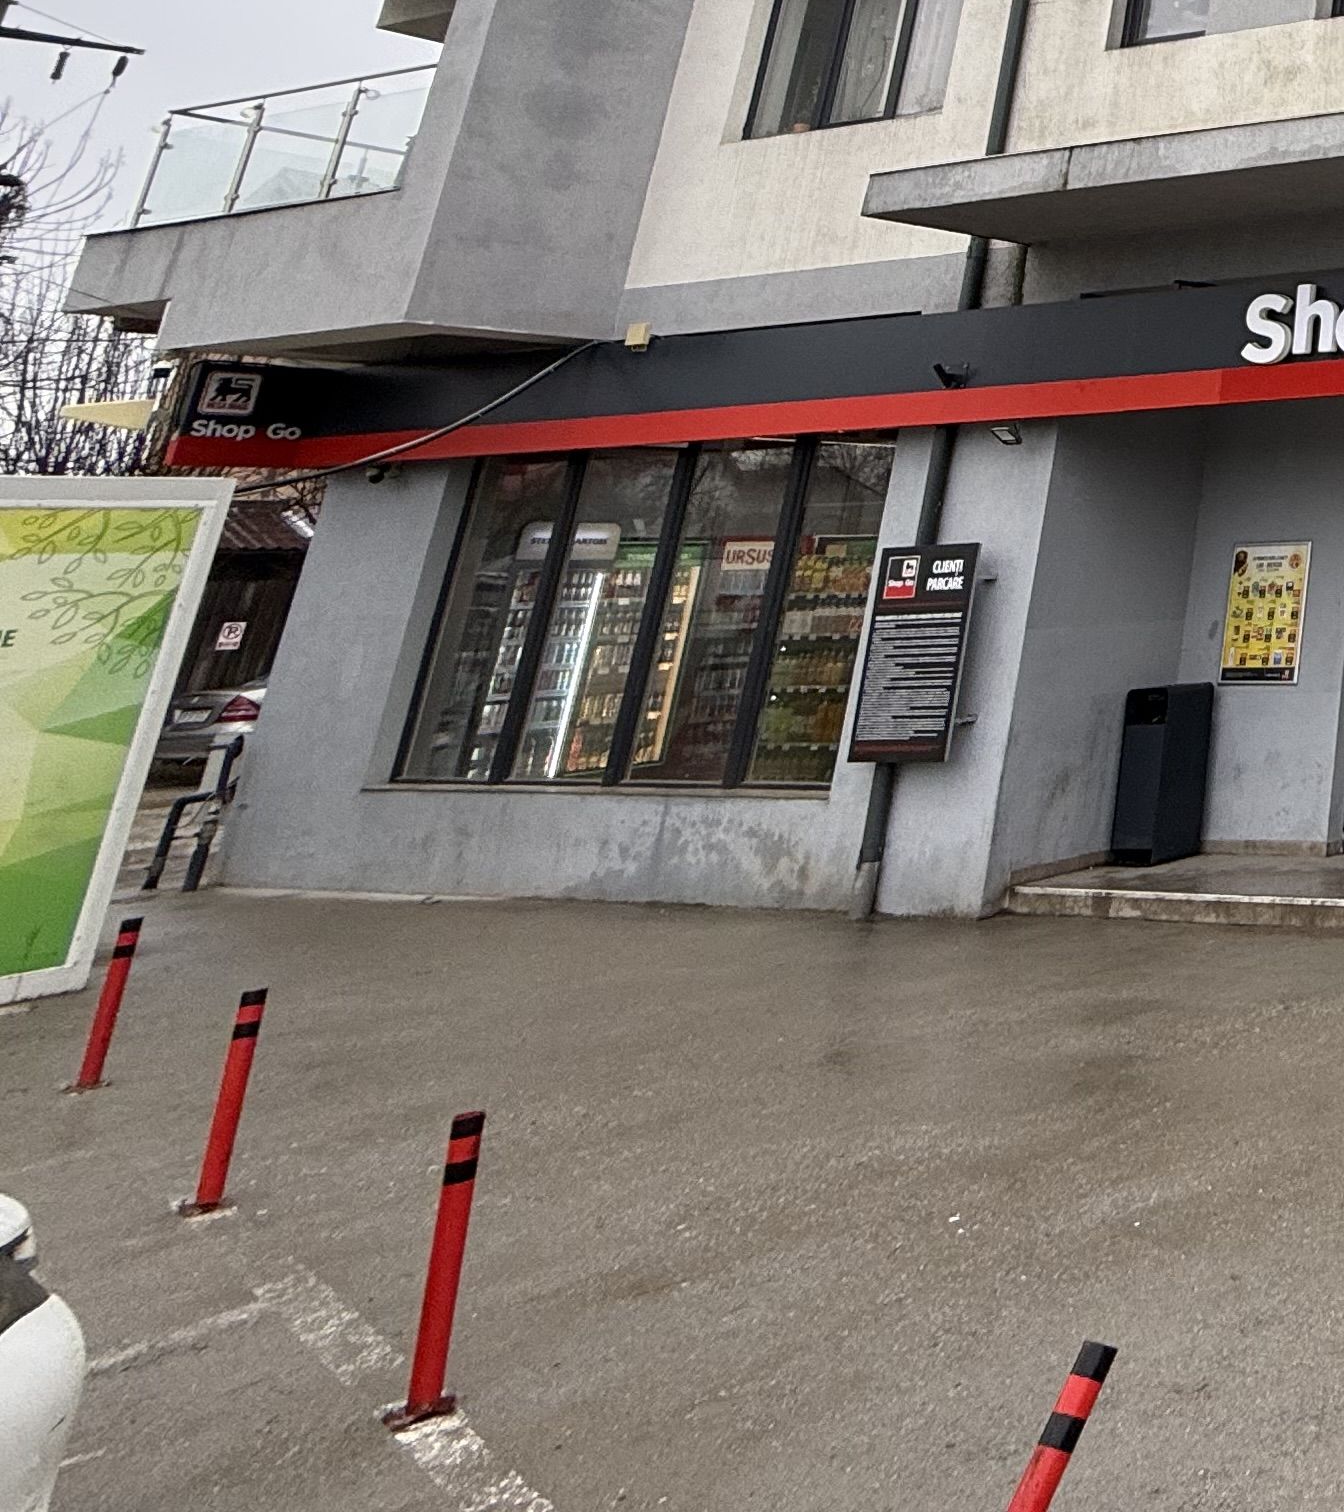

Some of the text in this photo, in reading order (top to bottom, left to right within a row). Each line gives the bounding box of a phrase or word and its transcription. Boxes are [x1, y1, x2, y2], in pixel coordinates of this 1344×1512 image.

[190, 419, 302, 441] Shop Go
[926, 576, 965, 591] PARCARE
